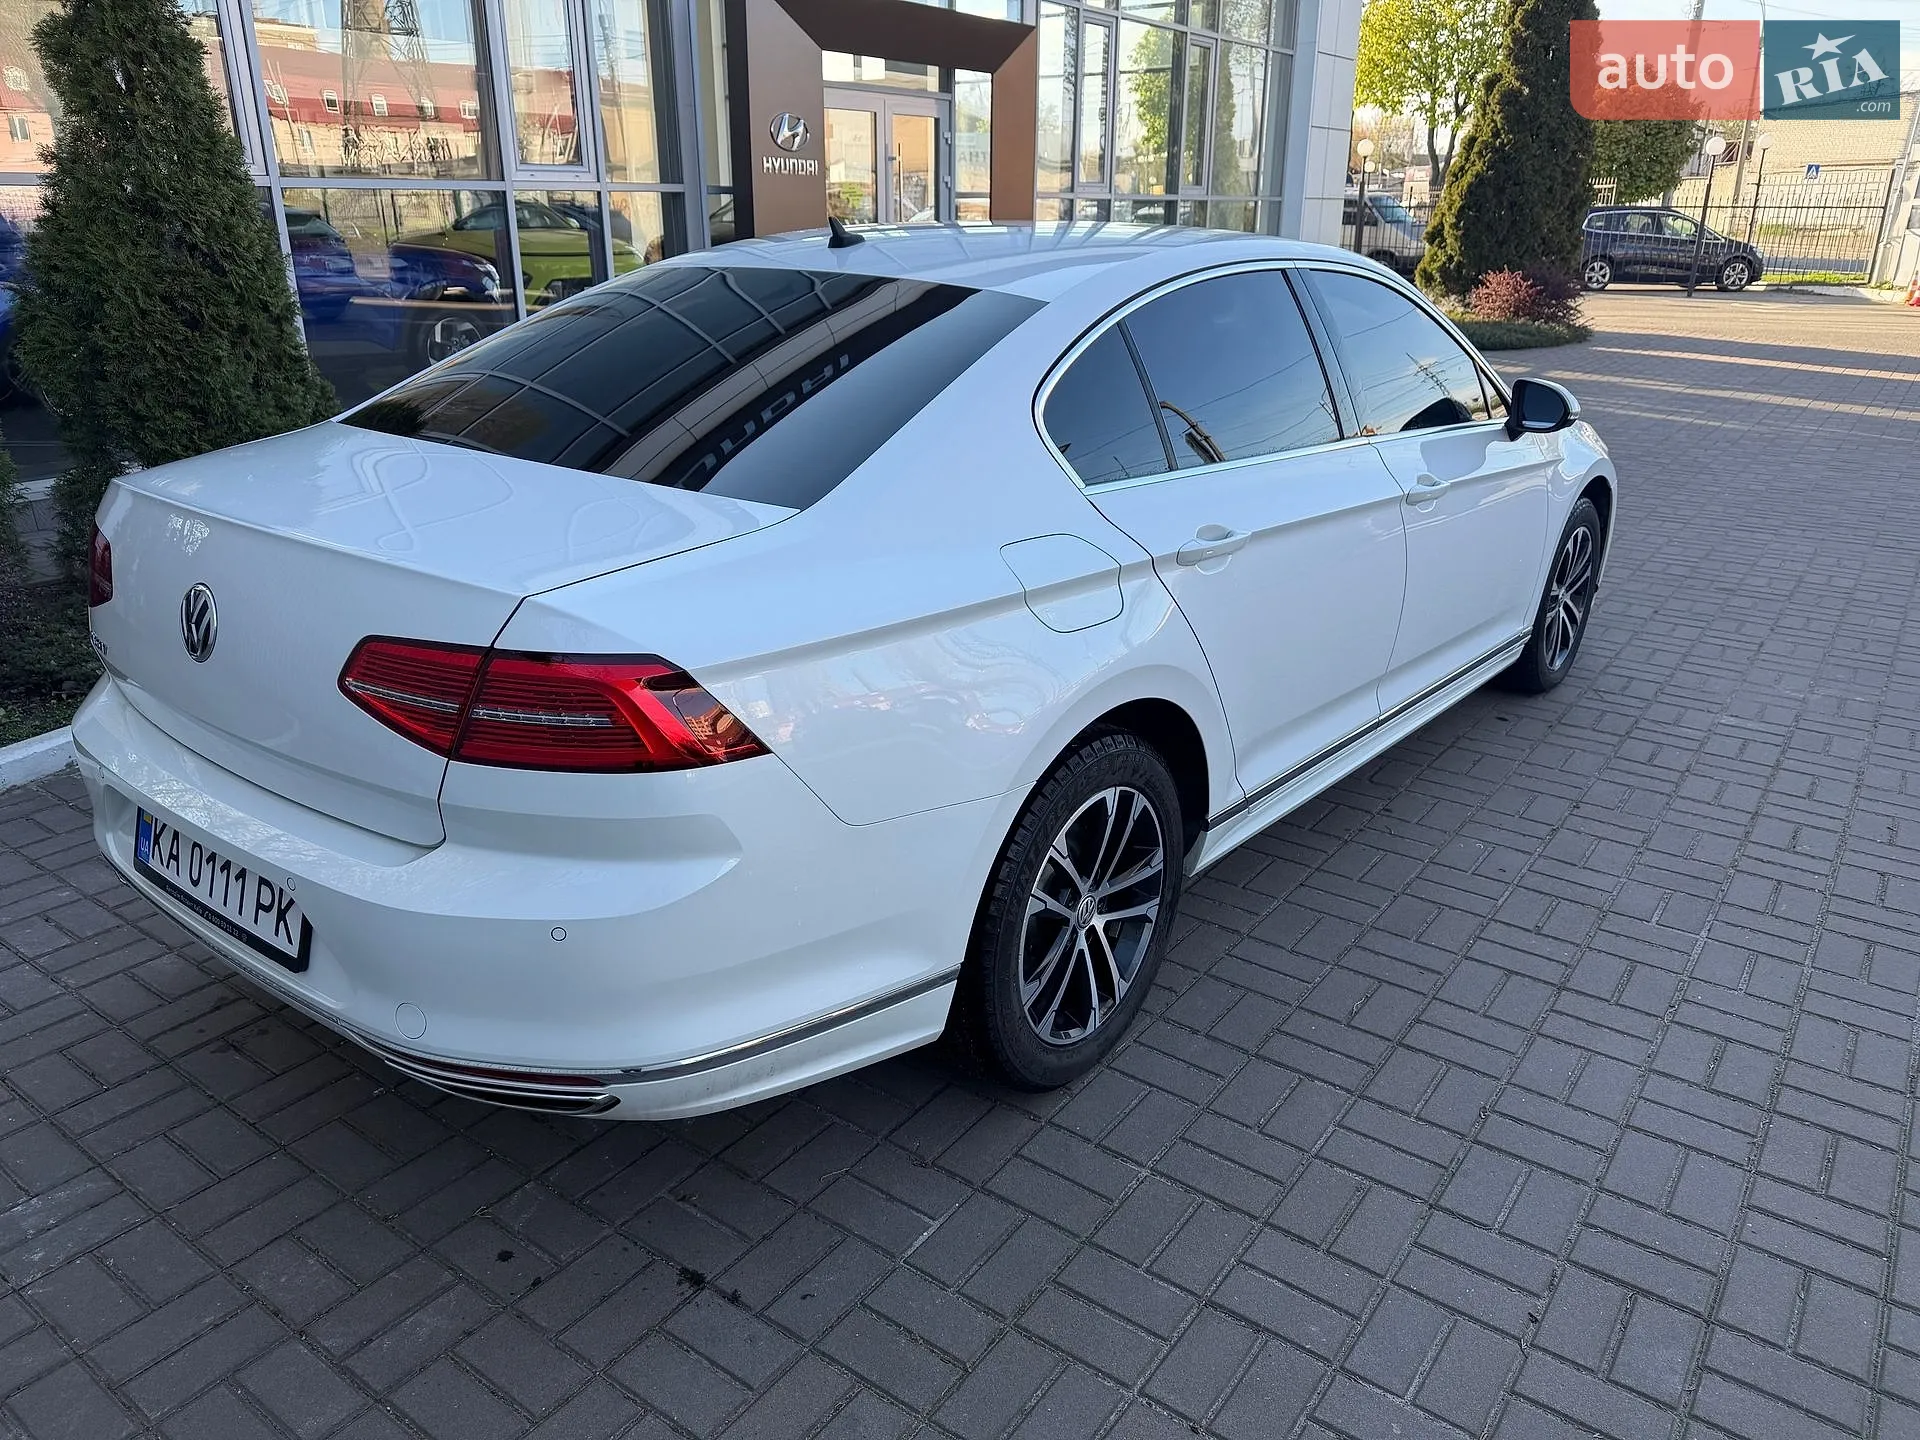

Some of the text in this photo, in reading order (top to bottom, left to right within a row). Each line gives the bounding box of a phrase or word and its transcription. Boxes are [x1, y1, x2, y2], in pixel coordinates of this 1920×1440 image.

[762, 155, 819, 176] HYUNDAI
[140, 837, 150, 854] UA
[152, 817, 181, 878] KA
[189, 841, 248, 917] 0111
[254, 875, 296, 946] PK
